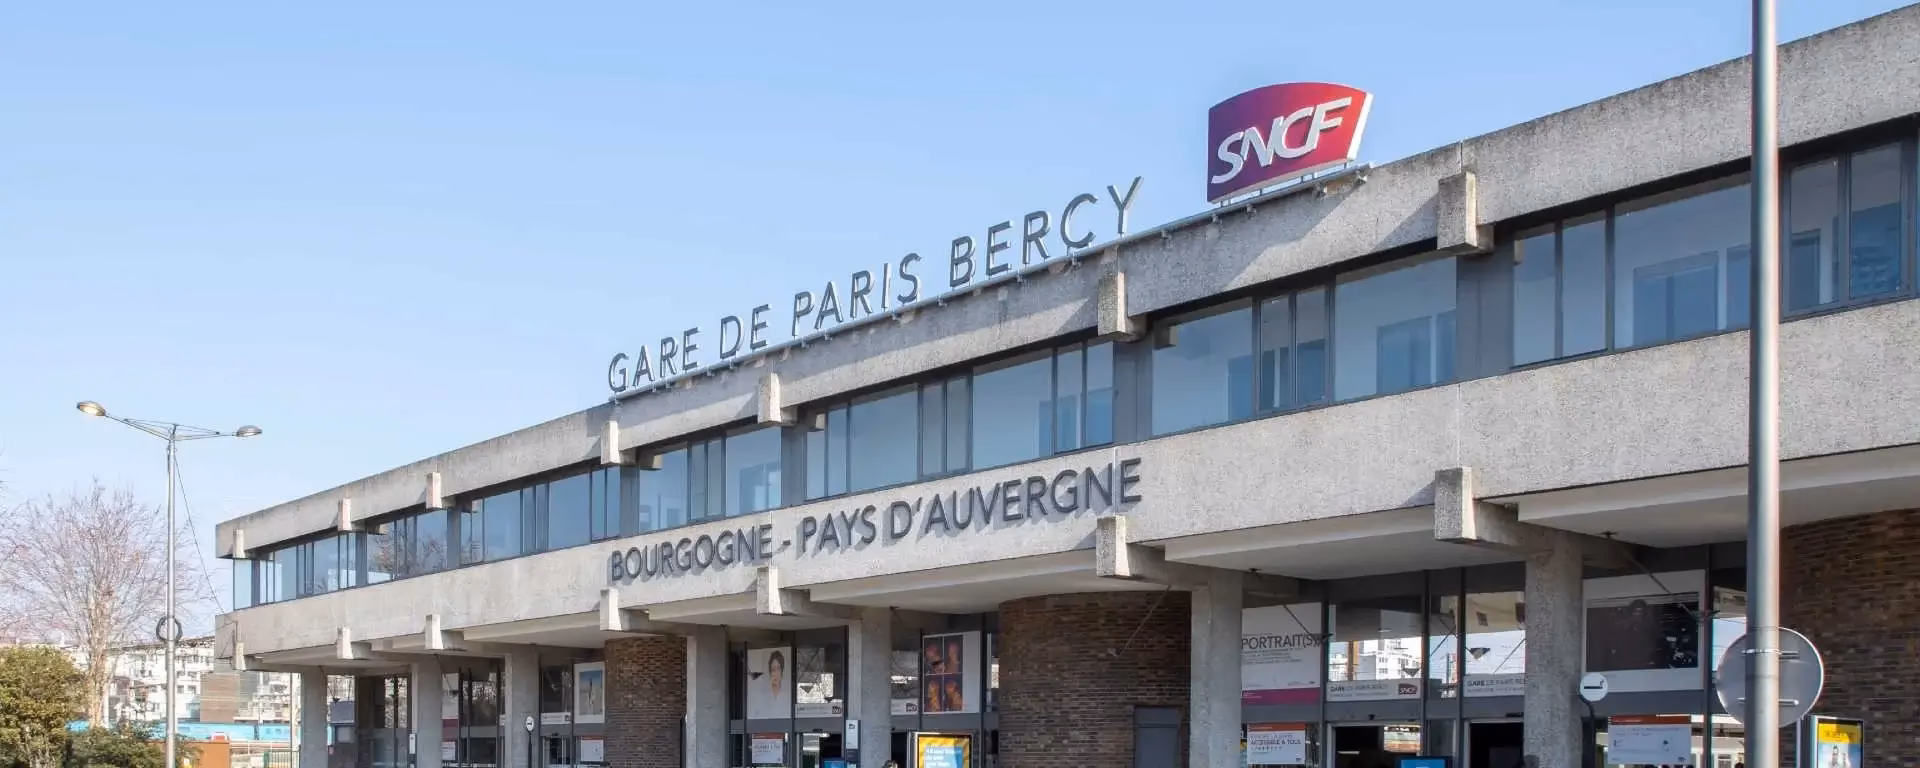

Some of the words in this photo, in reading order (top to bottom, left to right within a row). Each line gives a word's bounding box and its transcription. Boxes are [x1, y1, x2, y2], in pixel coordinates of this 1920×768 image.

[1211, 97, 1352, 184] SNCF
[608, 326, 700, 393] GARE
[719, 304, 772, 360] DE
[792, 252, 922, 337] PARIS
[950, 176, 1143, 288] BERCY
[610, 523, 772, 582] BOURGOGNE
[801, 505, 878, 553] PAYS
[890, 457, 1143, 541] D'AUVERGNE
